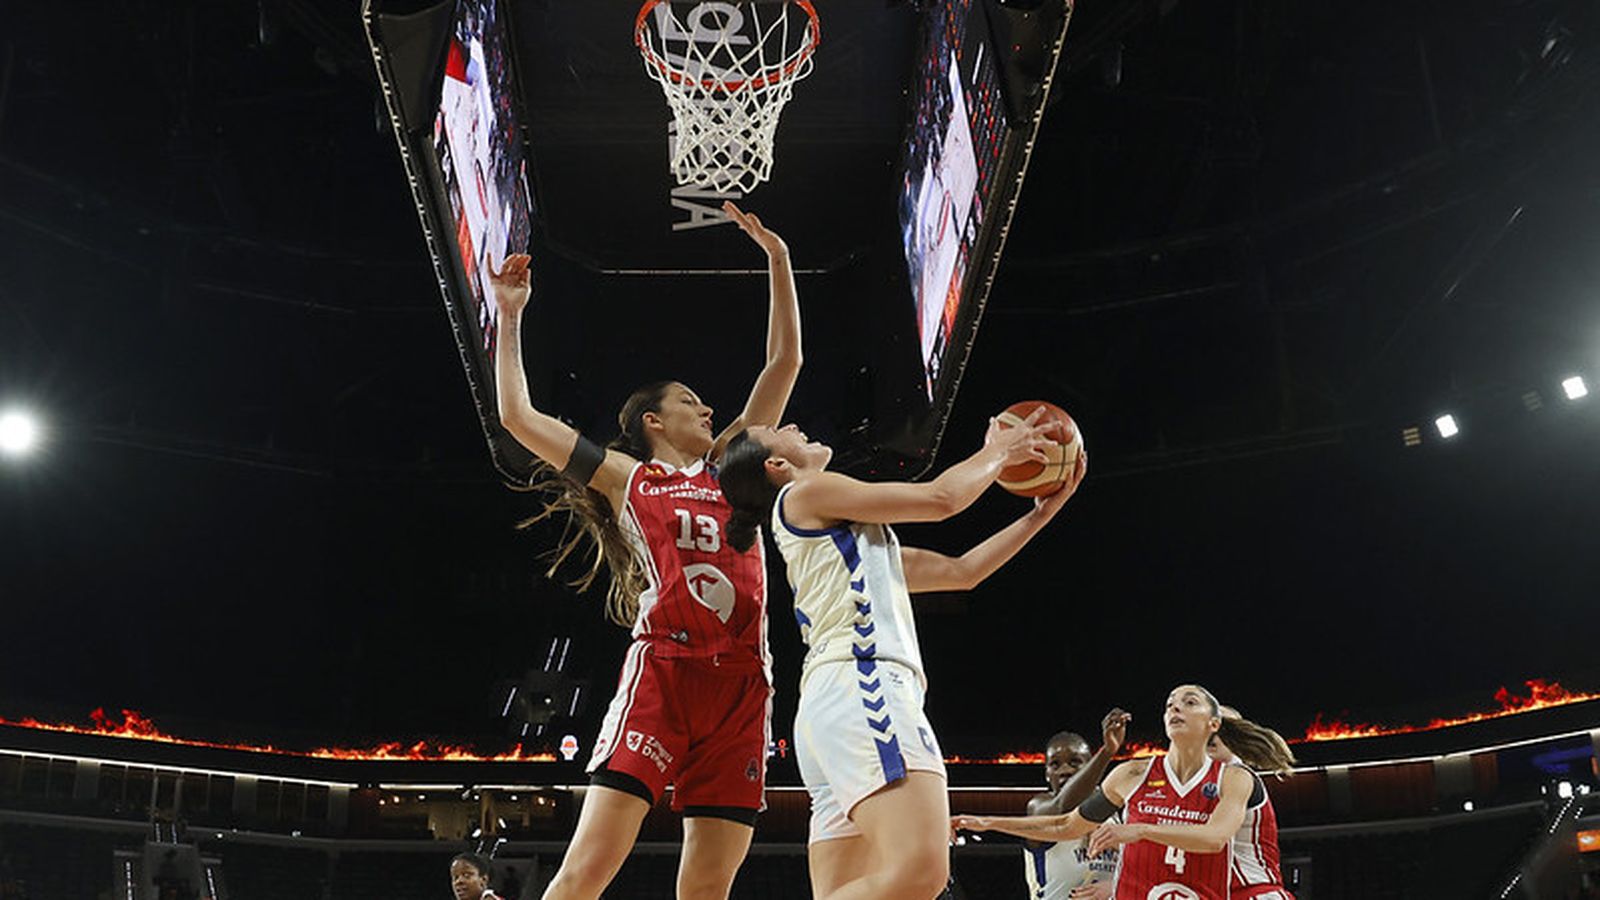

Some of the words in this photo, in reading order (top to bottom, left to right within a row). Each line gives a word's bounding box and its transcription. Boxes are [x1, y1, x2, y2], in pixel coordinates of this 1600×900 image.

[675, 508, 721, 553] 13
[1137, 800, 1209, 822] Casademo
[1164, 845, 1187, 874] 4
